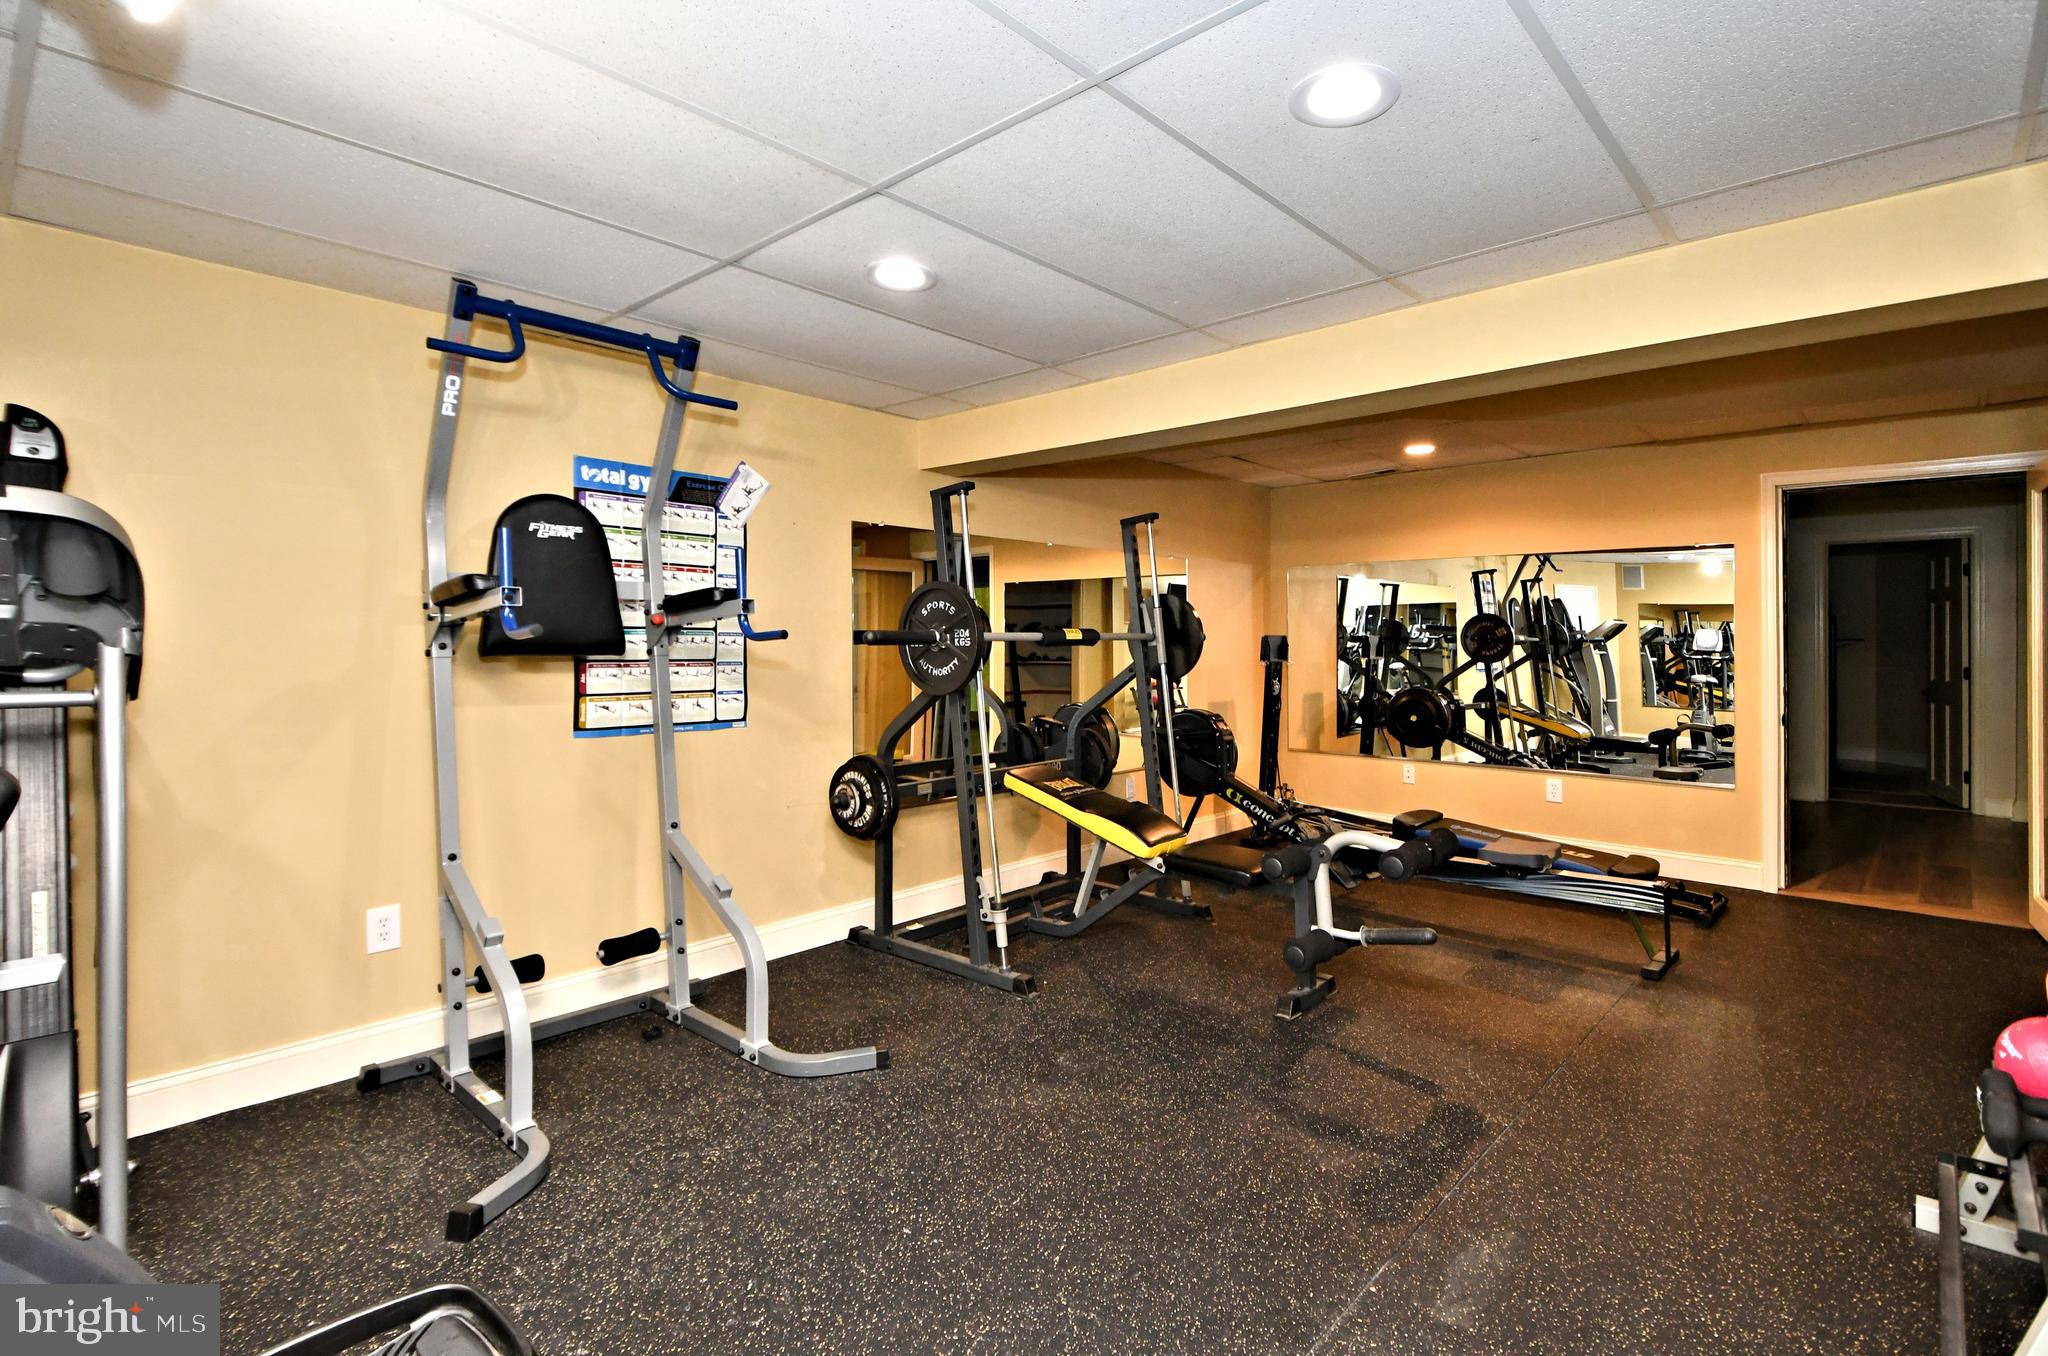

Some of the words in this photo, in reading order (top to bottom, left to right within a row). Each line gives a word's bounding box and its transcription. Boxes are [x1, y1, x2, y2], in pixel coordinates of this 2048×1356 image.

[441, 375, 461, 416] PRO
[580, 465, 626, 486] total
[628, 474, 652, 492] gy
[528, 521, 584, 533] FITNESS
[921, 600, 956, 617] SPORTS
[954, 638, 971, 647] KGS
[919, 657, 959, 677] AUTHORITY
[1242, 799, 1296, 837] concpt
